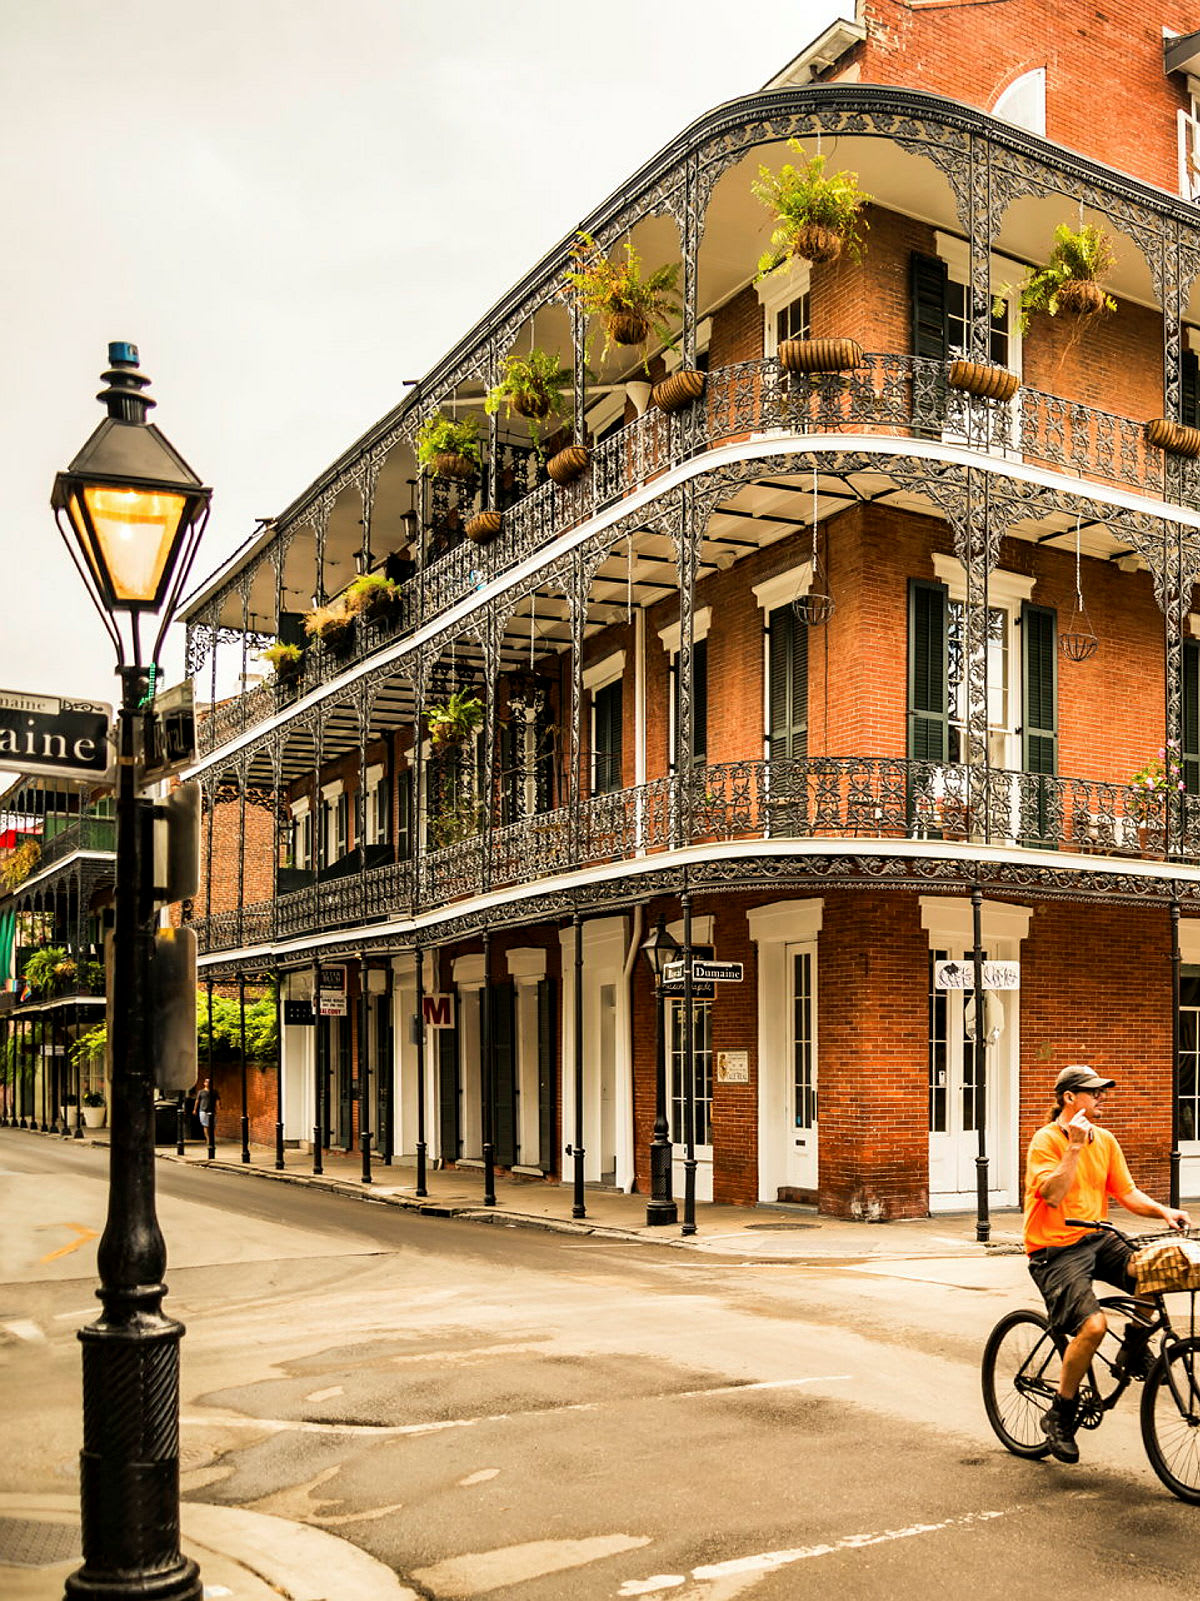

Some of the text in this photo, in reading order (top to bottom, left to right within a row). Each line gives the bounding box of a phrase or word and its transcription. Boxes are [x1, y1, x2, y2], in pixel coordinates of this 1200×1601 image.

[0, 718, 96, 761] aine
[696, 967, 740, 978] Dumaine
[424, 997, 450, 1024] M
